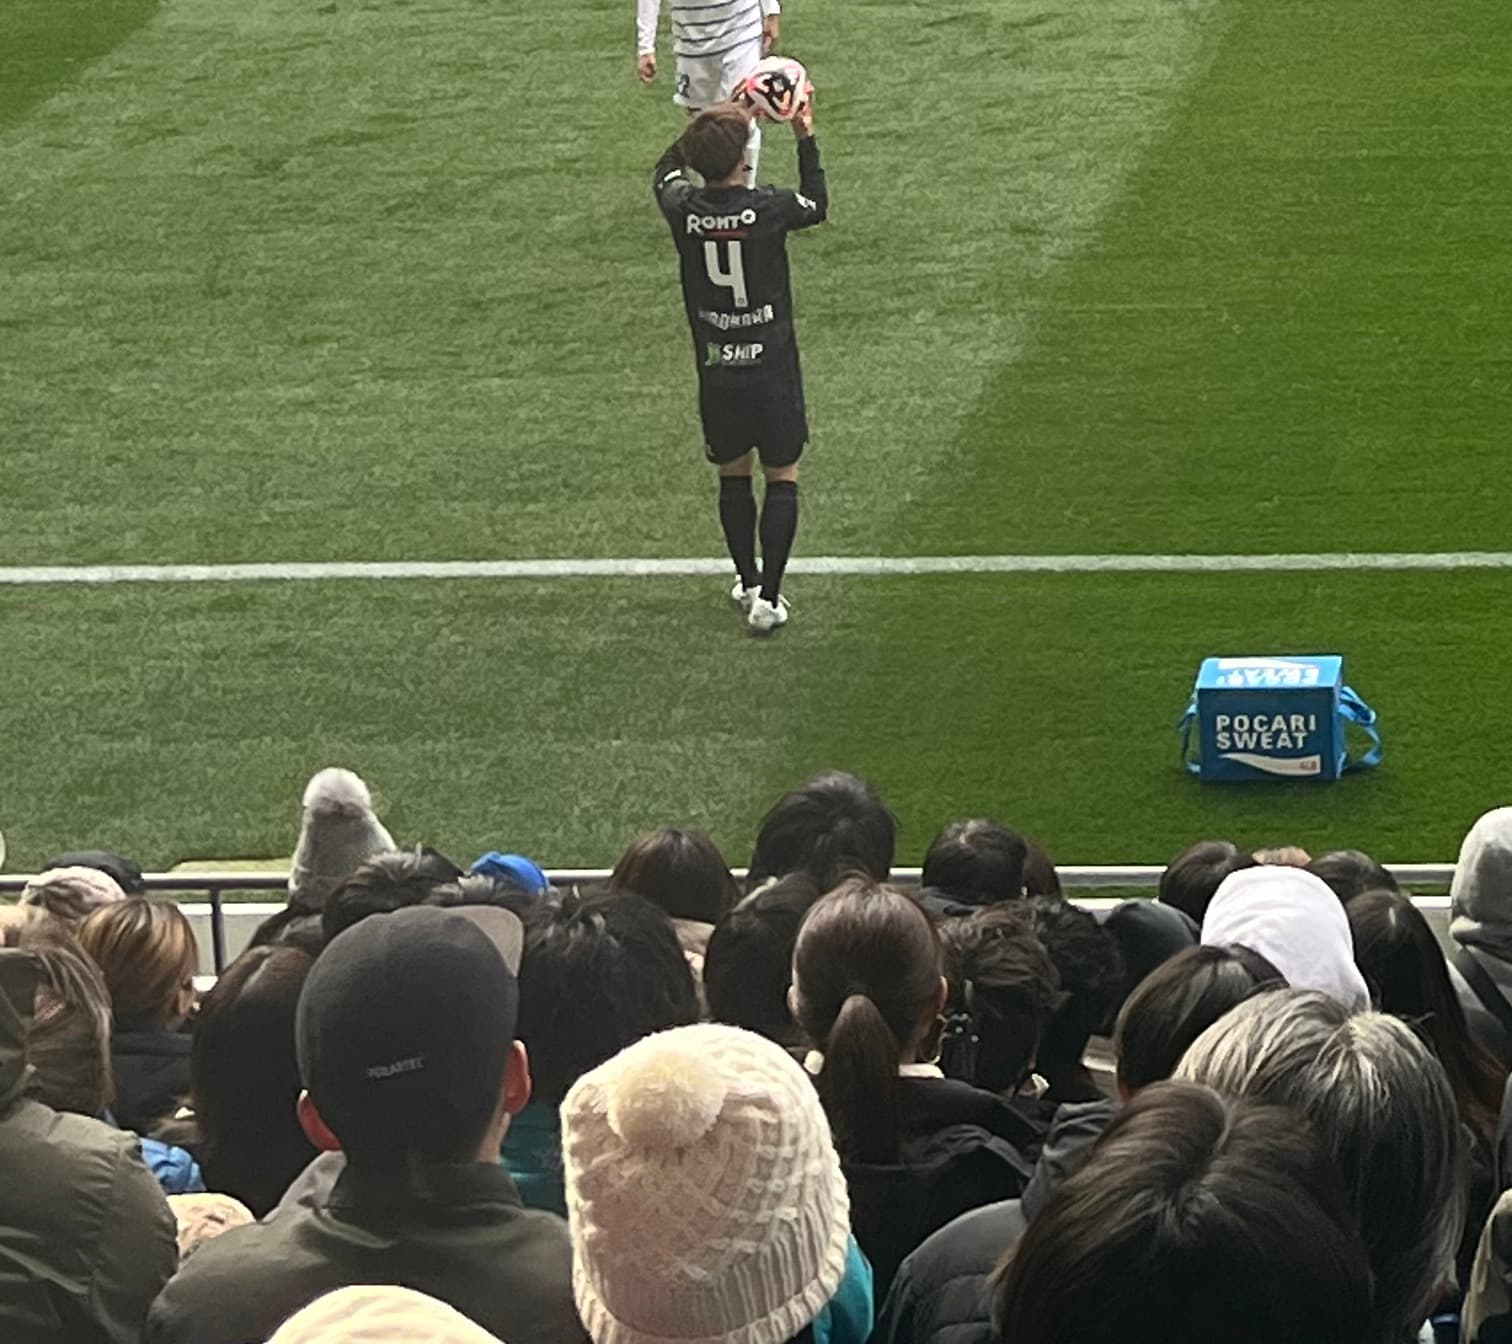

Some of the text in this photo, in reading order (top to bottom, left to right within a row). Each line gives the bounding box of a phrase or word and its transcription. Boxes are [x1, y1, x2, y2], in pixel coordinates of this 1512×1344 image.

[703, 240, 749, 308] 4
[721, 343, 764, 361] SHIP
[1215, 714, 1317, 732] POCARI
[1215, 731, 1307, 750] SWEAT
